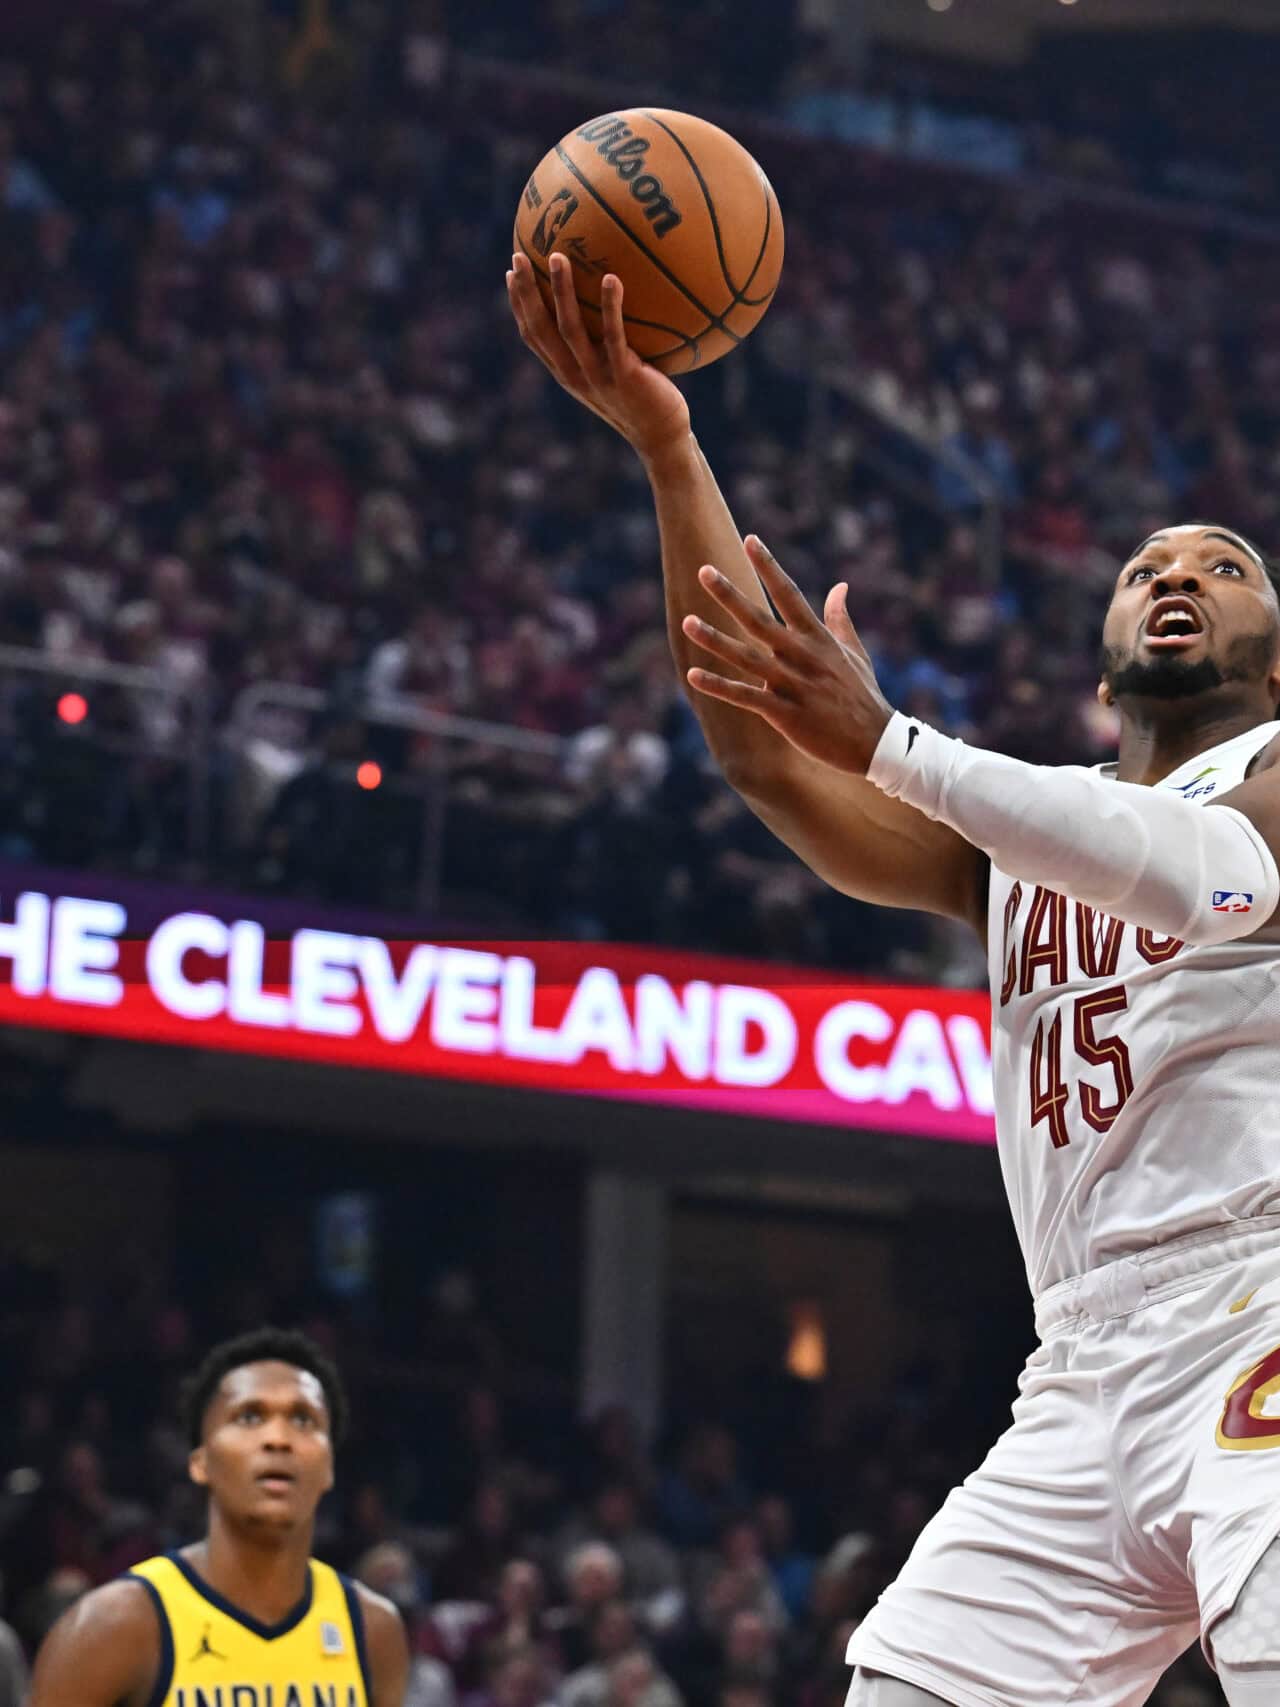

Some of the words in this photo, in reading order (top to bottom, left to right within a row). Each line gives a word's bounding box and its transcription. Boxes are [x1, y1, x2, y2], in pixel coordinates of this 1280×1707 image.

[576, 114, 682, 240] Wilson
[146, 911, 797, 1088] CLEVELAND
[1030, 984, 1135, 1149] 45
